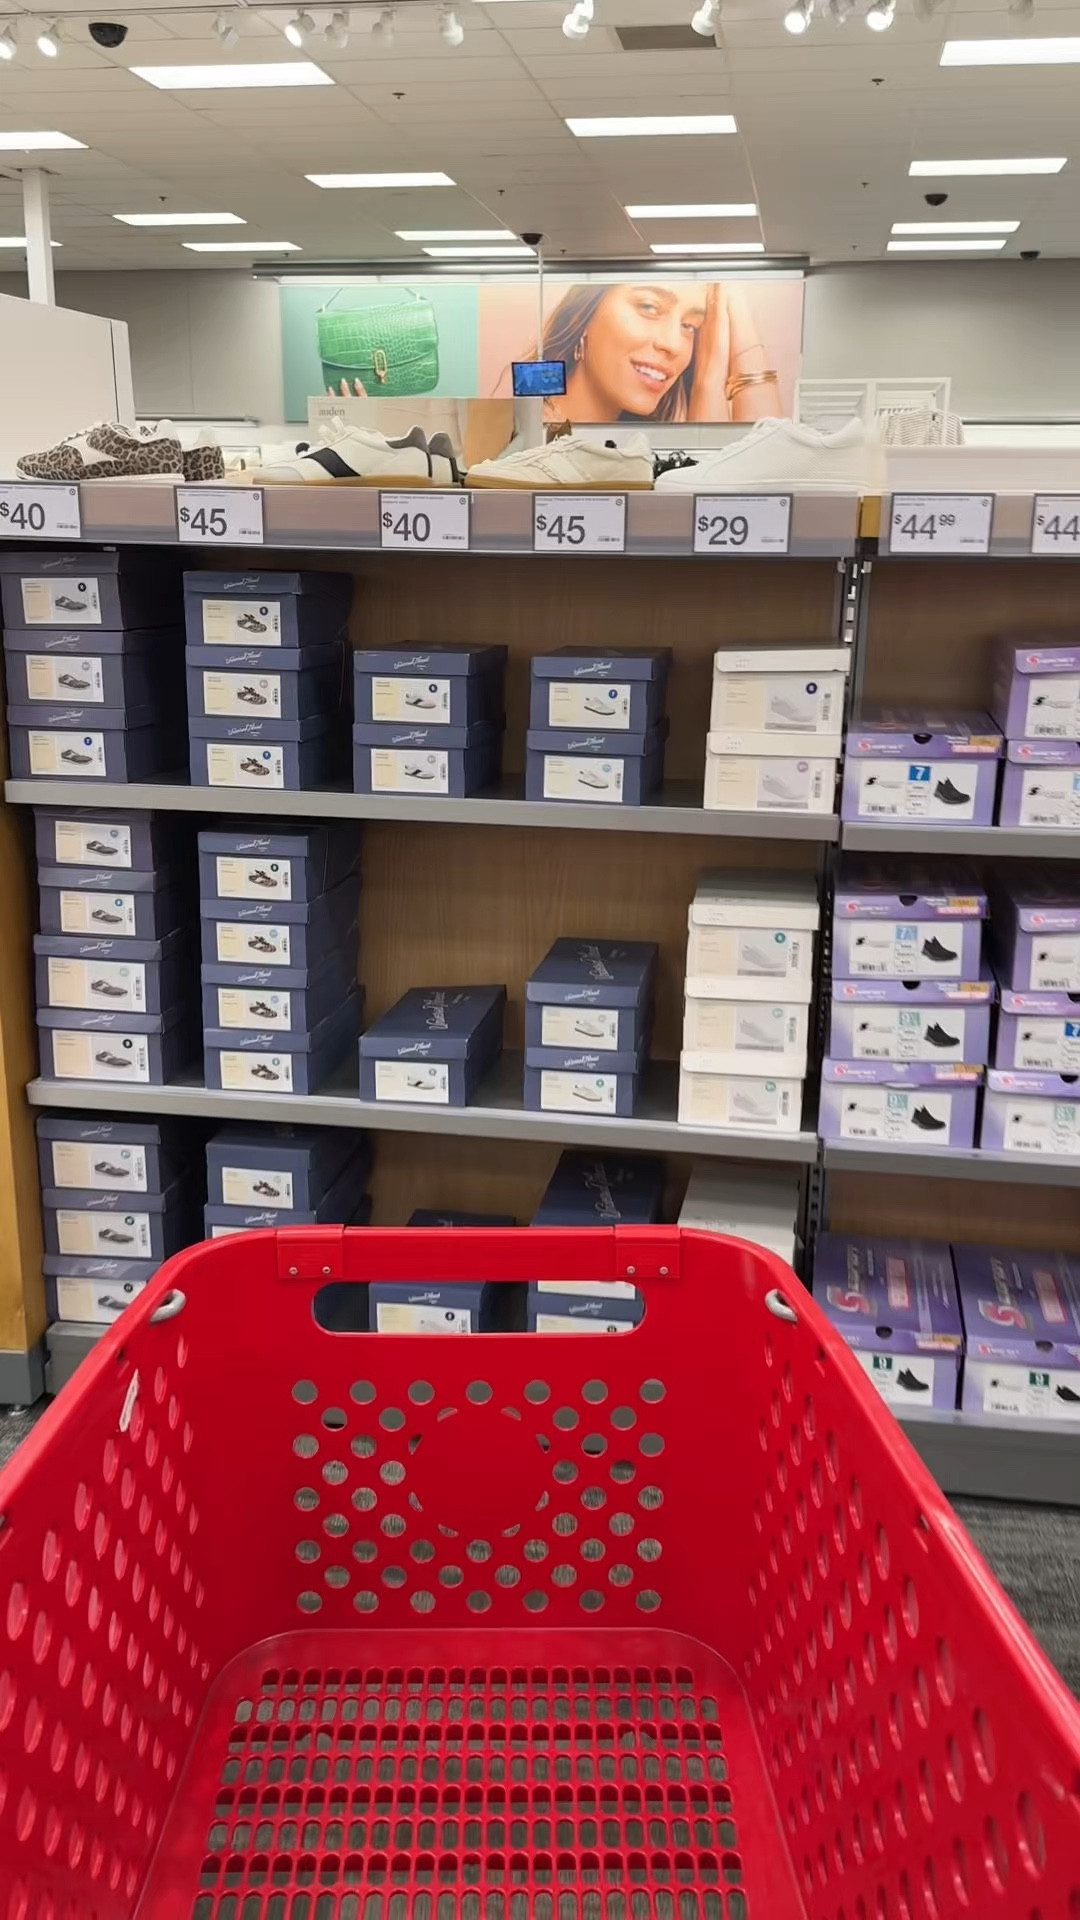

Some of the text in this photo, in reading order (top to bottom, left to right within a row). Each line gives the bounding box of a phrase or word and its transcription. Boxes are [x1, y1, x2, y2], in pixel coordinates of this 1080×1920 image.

[318, 407, 345, 416] auden
[0, 502, 45, 530] $40
[179, 506, 227, 536] $45
[382, 511, 431, 542] $40
[536, 514, 585, 544] $45
[698, 515, 749, 545] $29
[915, 766, 926, 780] 7
